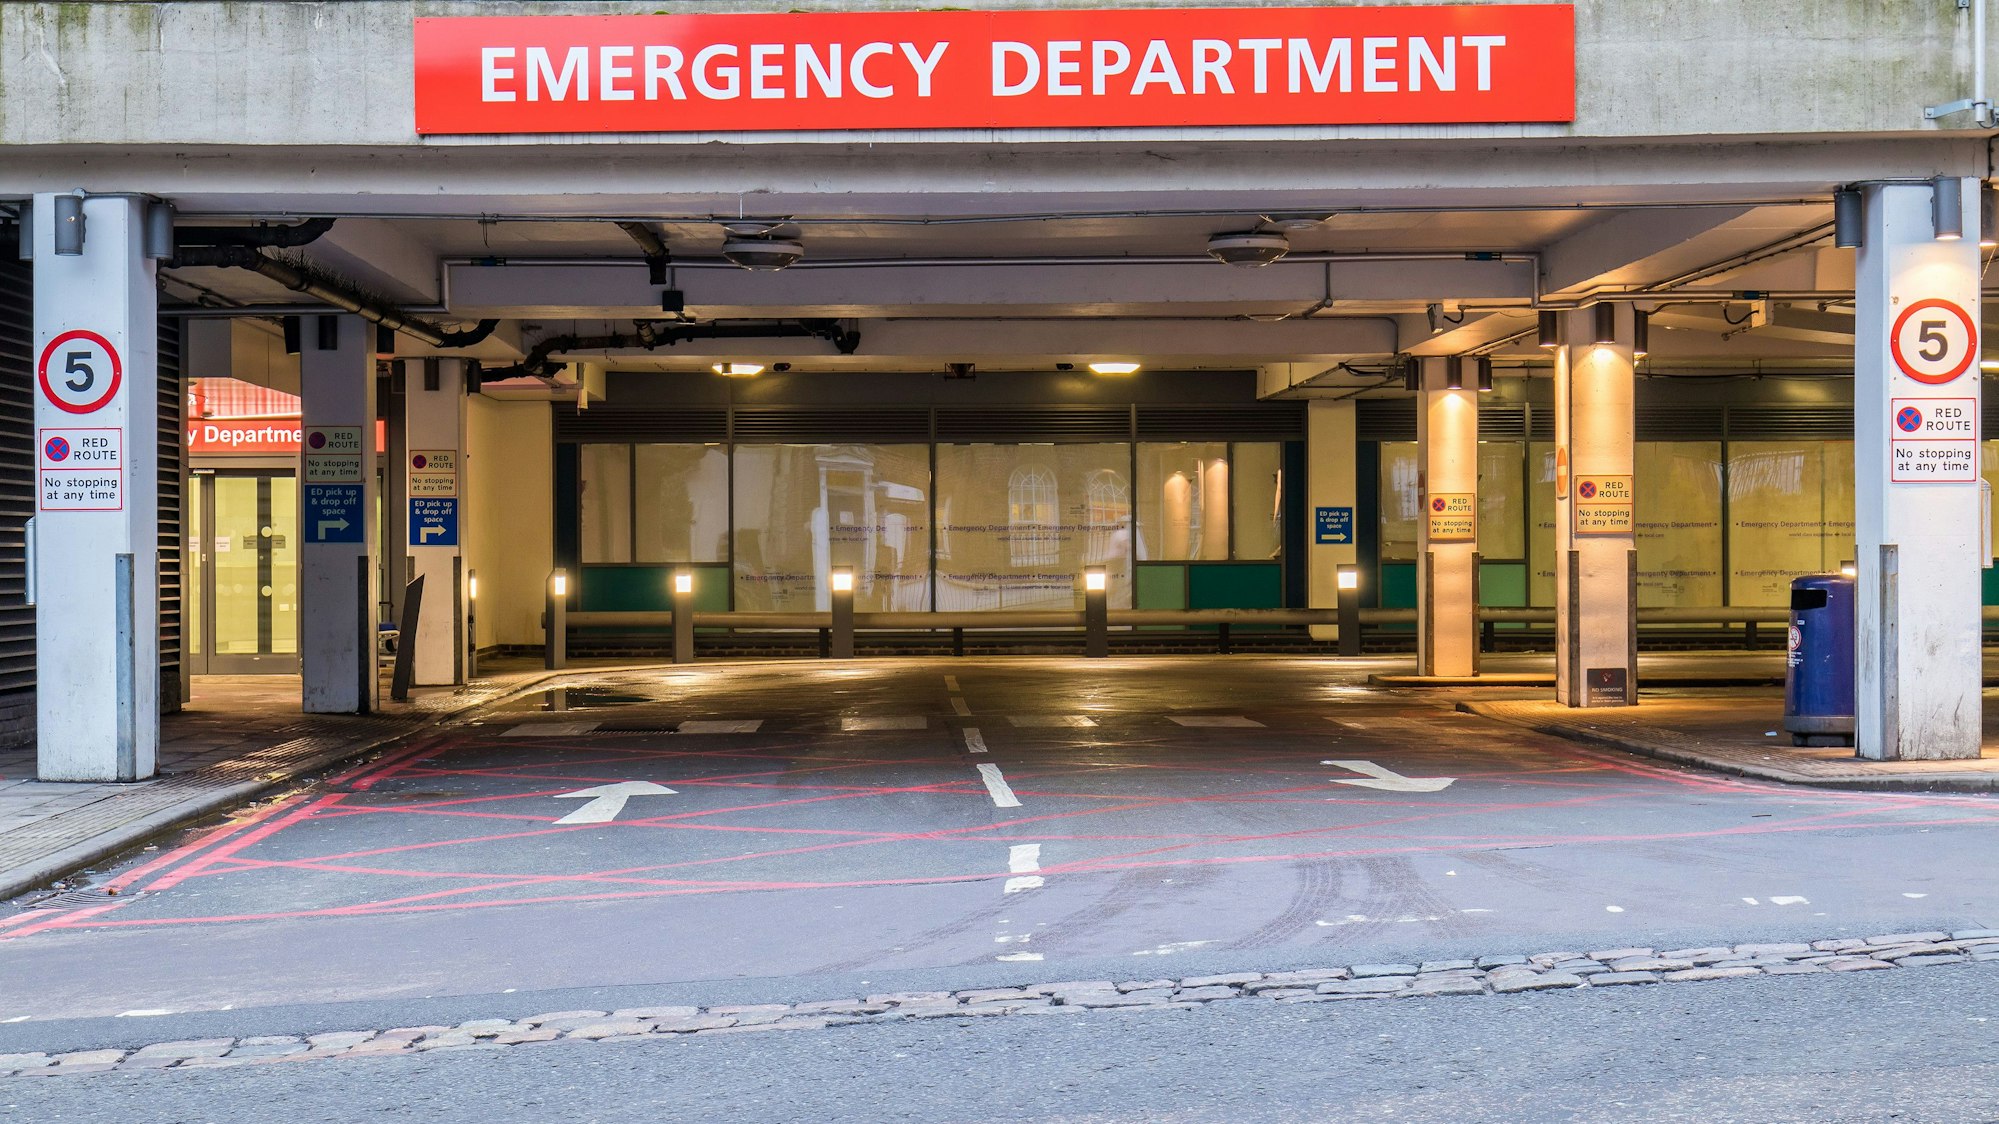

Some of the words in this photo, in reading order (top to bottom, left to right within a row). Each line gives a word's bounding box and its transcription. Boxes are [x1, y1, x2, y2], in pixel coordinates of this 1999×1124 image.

[481, 40, 950, 103] EMERGENCY
[992, 35, 1506, 97] DEPARTMENT
[1918, 320, 1949, 362] 5
[65, 351, 95, 393] 5
[1935, 408, 1962, 418] RED
[1926, 421, 1971, 431] ROUTE
[334, 432, 353, 440] RED
[82, 438, 109, 448] RED
[73, 451, 117, 461] ROUTE
[1896, 448, 1913, 458] No
[1919, 448, 1972, 460] stopping
[324, 460, 360, 468] stopping
[1898, 461, 1910, 471] at
[1915, 463, 1938, 473] any
[1943, 461, 1969, 471] time
[44, 477, 61, 488] No
[66, 477, 118, 488] stopping
[46, 490, 59, 500] at
[63, 492, 84, 502] any
[90, 490, 116, 500] time
[311, 488, 323, 496] ED
[326, 488, 342, 497] pick
[346, 489, 357, 497] up
[320, 498, 340, 506] drop
[322, 508, 346, 516] space
[422, 508, 439, 516] drop
[1594, 510, 1630, 518] stopping
[988, 524, 1030, 532] Department
[1741, 520, 1778, 528] Emergency
[1038, 574, 1075, 582] Emergency
